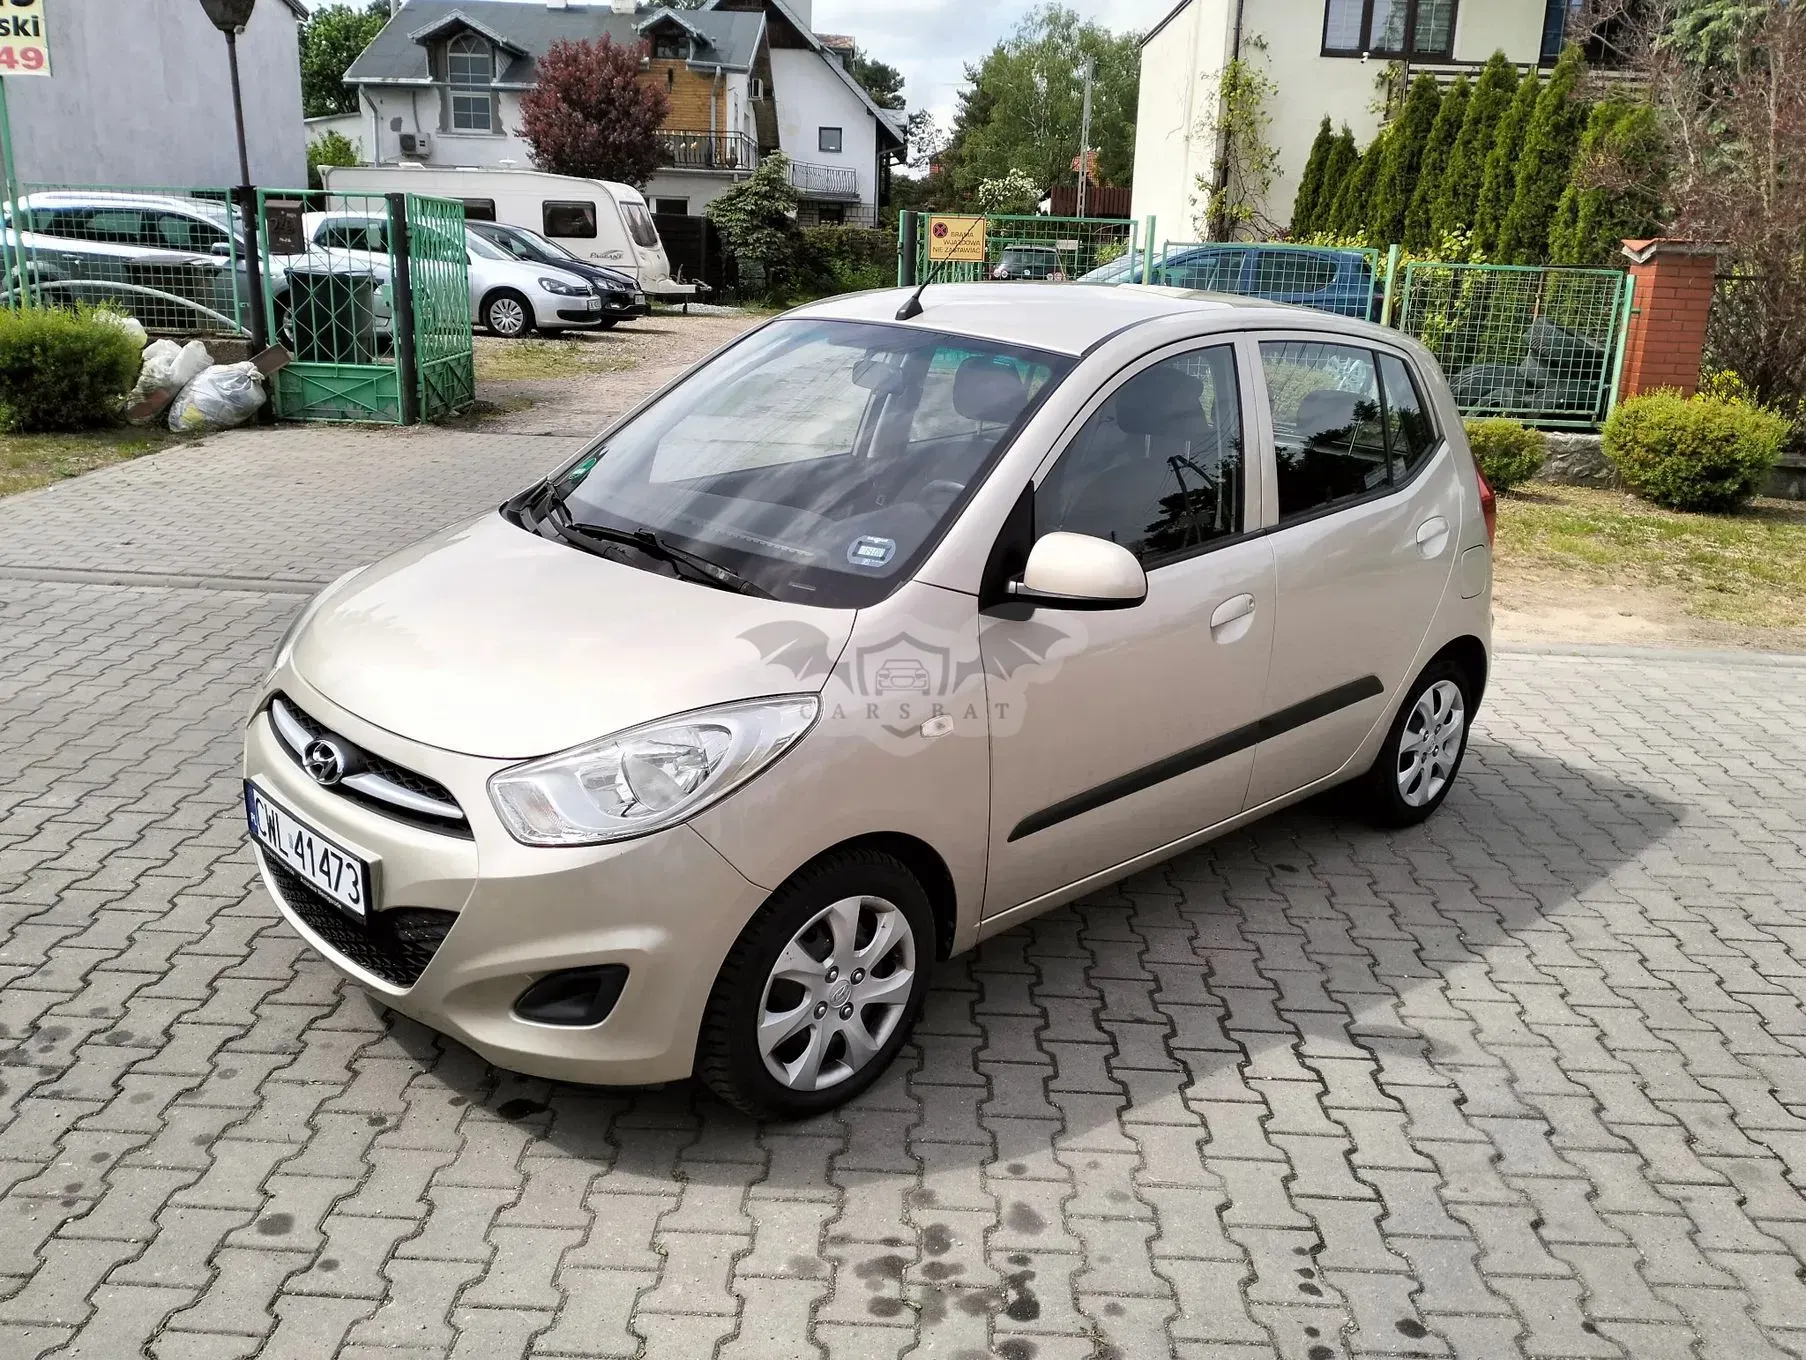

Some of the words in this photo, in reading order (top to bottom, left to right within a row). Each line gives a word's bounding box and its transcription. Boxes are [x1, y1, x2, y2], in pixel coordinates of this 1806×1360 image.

[0, 46, 44, 70] 49
[256, 797, 288, 858] CWL
[294, 830, 360, 905] 41473
